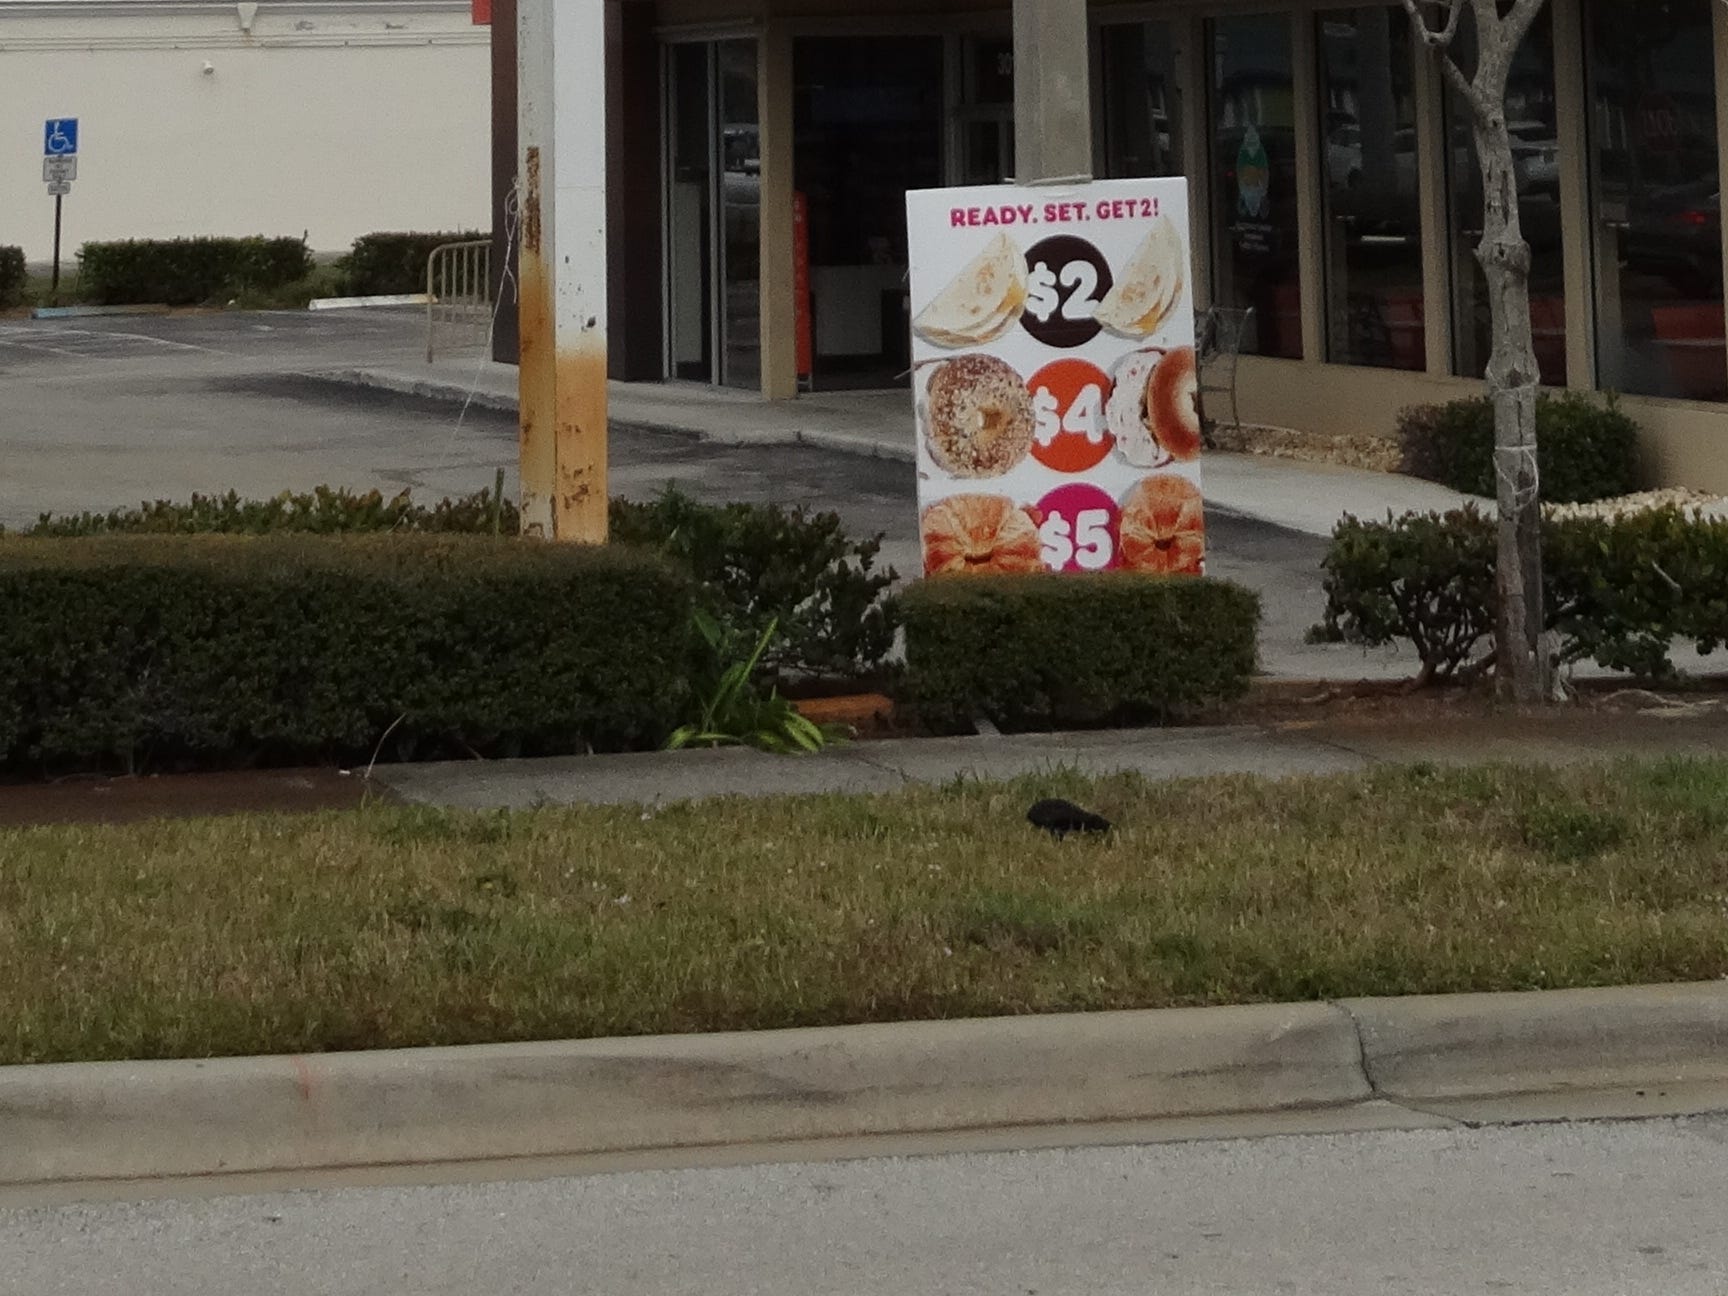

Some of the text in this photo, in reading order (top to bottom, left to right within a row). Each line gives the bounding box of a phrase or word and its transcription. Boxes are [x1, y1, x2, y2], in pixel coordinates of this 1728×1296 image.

[950, 205, 1038, 227] READY.
[1044, 202, 1090, 223] SET.
[1027, 259, 1102, 322] $2
[1033, 382, 1108, 447] $4
[1039, 508, 1113, 571] $5
